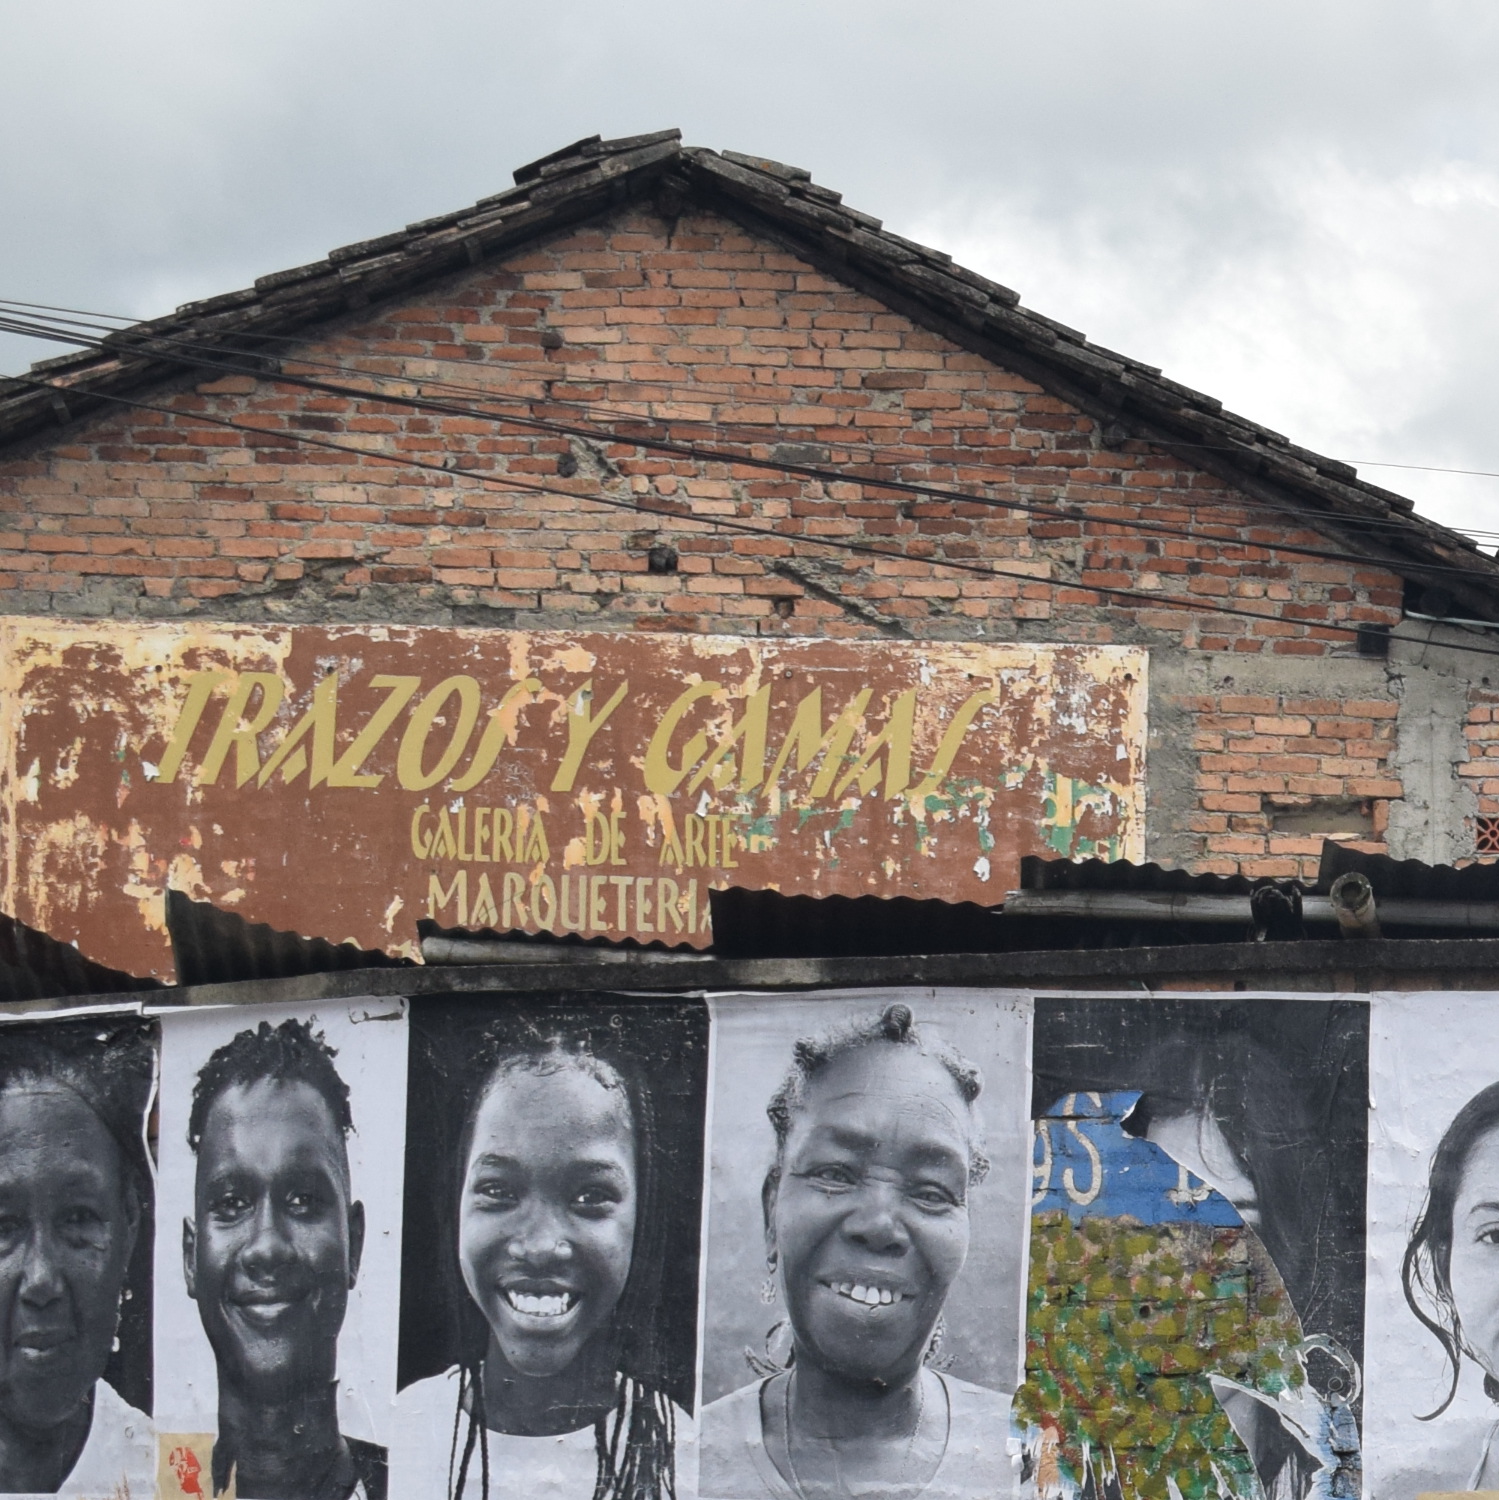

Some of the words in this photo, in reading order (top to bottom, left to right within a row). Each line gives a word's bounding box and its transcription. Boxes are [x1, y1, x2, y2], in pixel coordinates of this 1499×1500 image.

[156, 671, 543, 792] TRAZOS
[550, 678, 629, 792] Y
[644, 681, 996, 802] GAMAS
[586, 811, 628, 866] DE
[658, 813, 739, 868] ARTE
